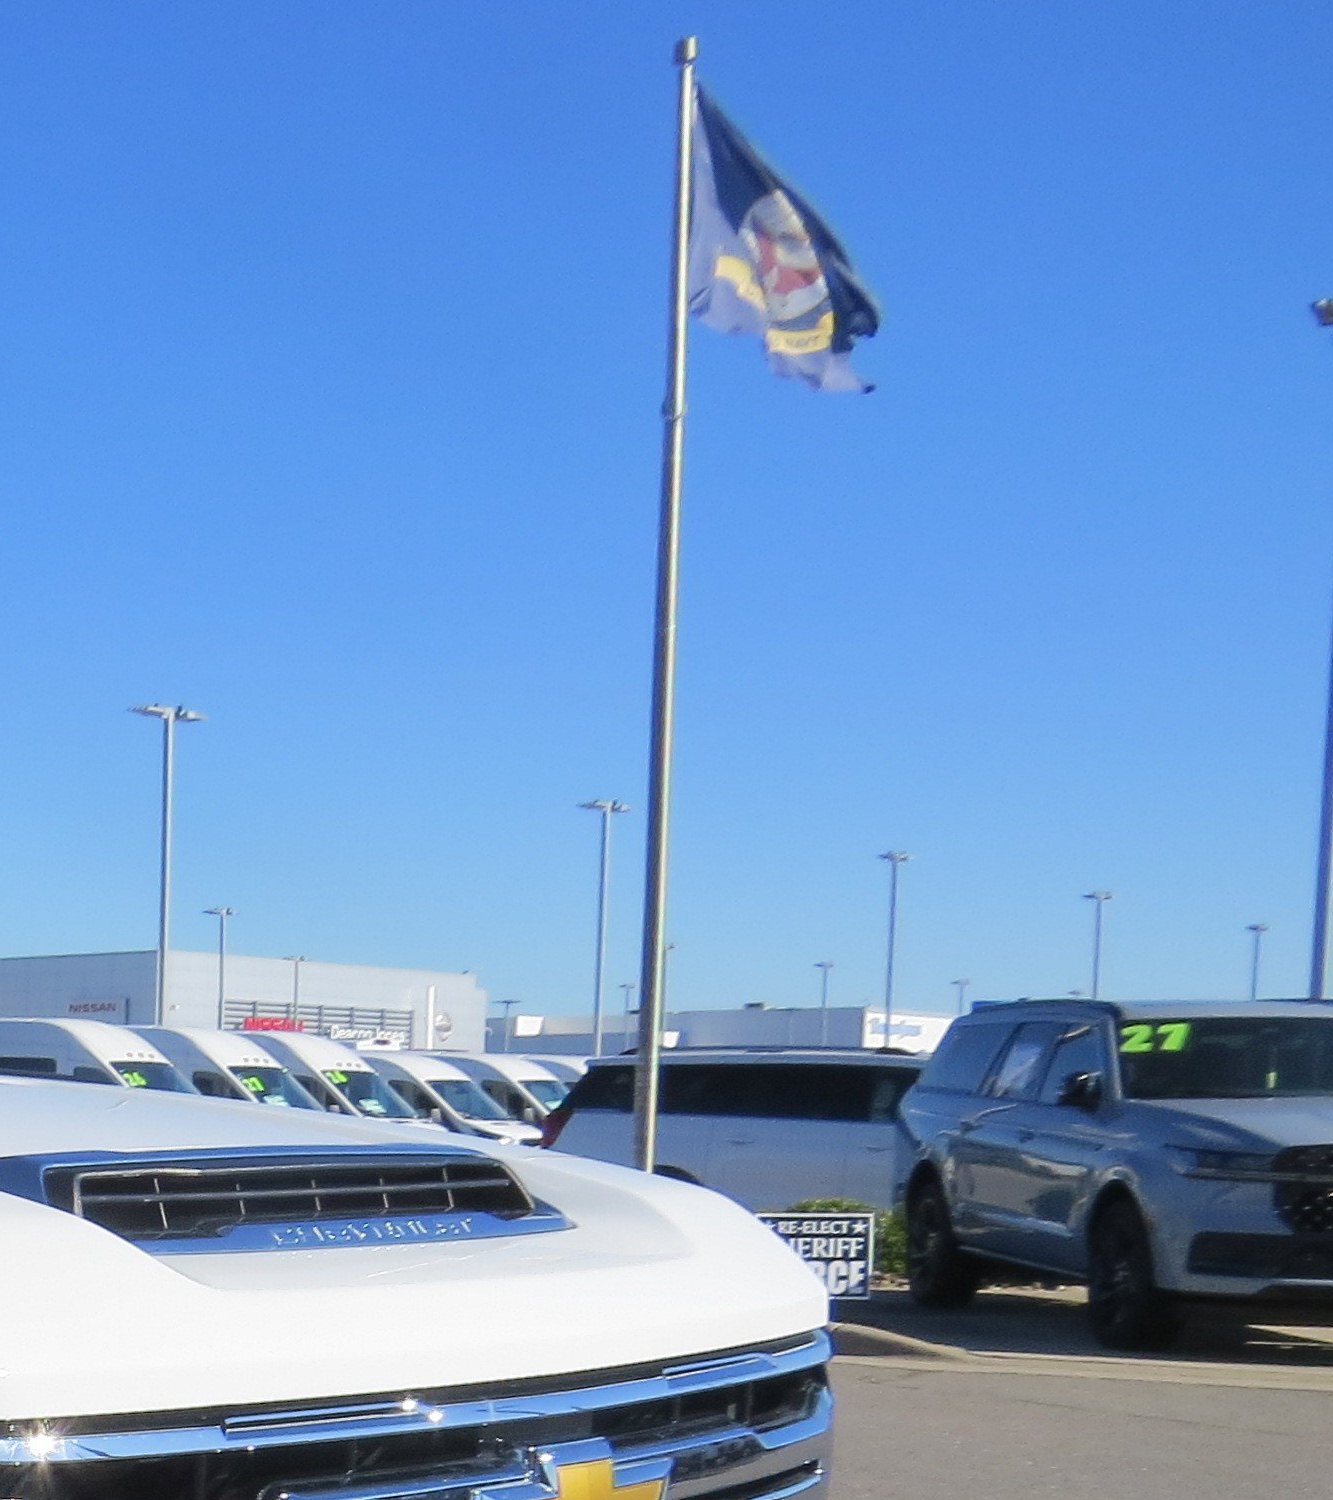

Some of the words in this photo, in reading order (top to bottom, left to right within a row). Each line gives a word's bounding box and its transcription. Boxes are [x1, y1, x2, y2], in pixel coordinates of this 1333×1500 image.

[68, 1002, 117, 1013] NISSAN
[1119, 1023, 1191, 1053] 27
[778, 1220, 850, 1234] RE-ELECT
[789, 1237, 865, 1258] ERIFF
